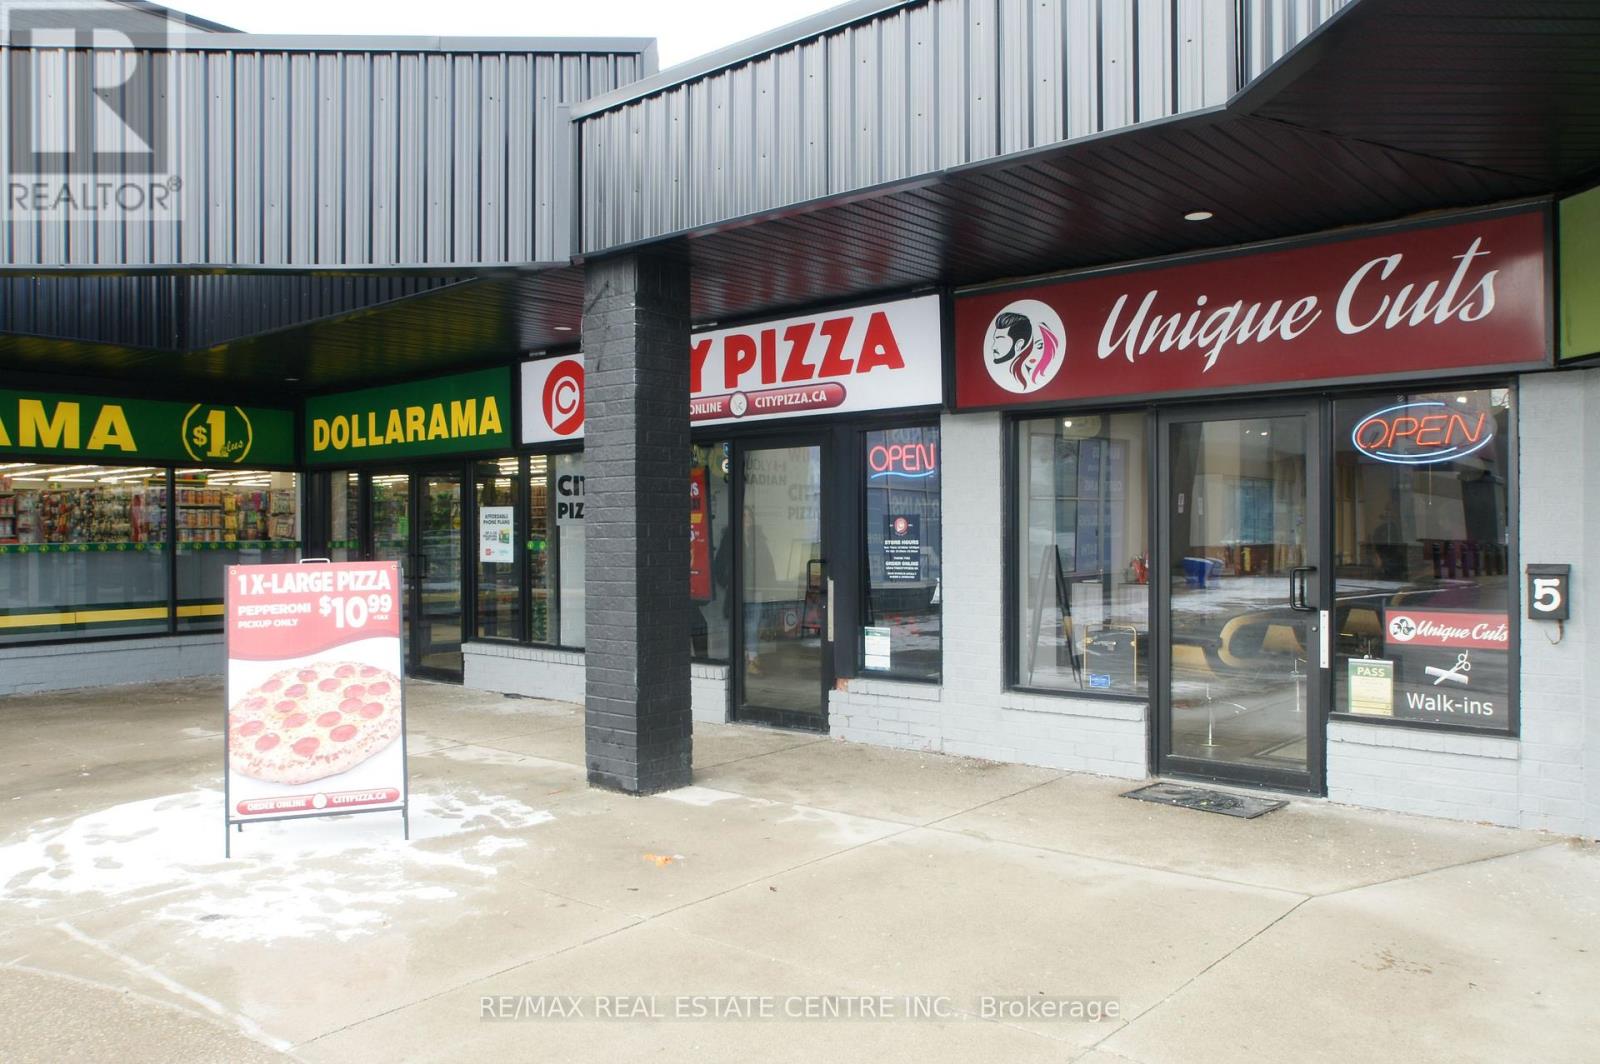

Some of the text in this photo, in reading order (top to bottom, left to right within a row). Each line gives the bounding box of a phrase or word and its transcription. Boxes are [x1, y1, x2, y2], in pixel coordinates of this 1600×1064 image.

[1098, 236, 1500, 373] Unique Cuts
[724, 311, 905, 389] PIZZA
[755, 390, 827, 408] CITYPIZZA.CA
[0, 399, 138, 451] MA
[313, 396, 502, 451] DOLLARAMA
[1357, 412, 1486, 448] OPEN
[869, 442, 935, 471] OPEN
[238, 569, 392, 595] 1 X-LARGE PIZZA
[1533, 578, 1561, 612] 5
[238, 602, 311, 616] PEPPERONI
[238, 618, 298, 628] PICKUP ONLY
[1417, 620, 1508, 642] Unique Cuts
[1357, 666, 1385, 677] PASS
[1407, 692, 1494, 716] Walk-ins
